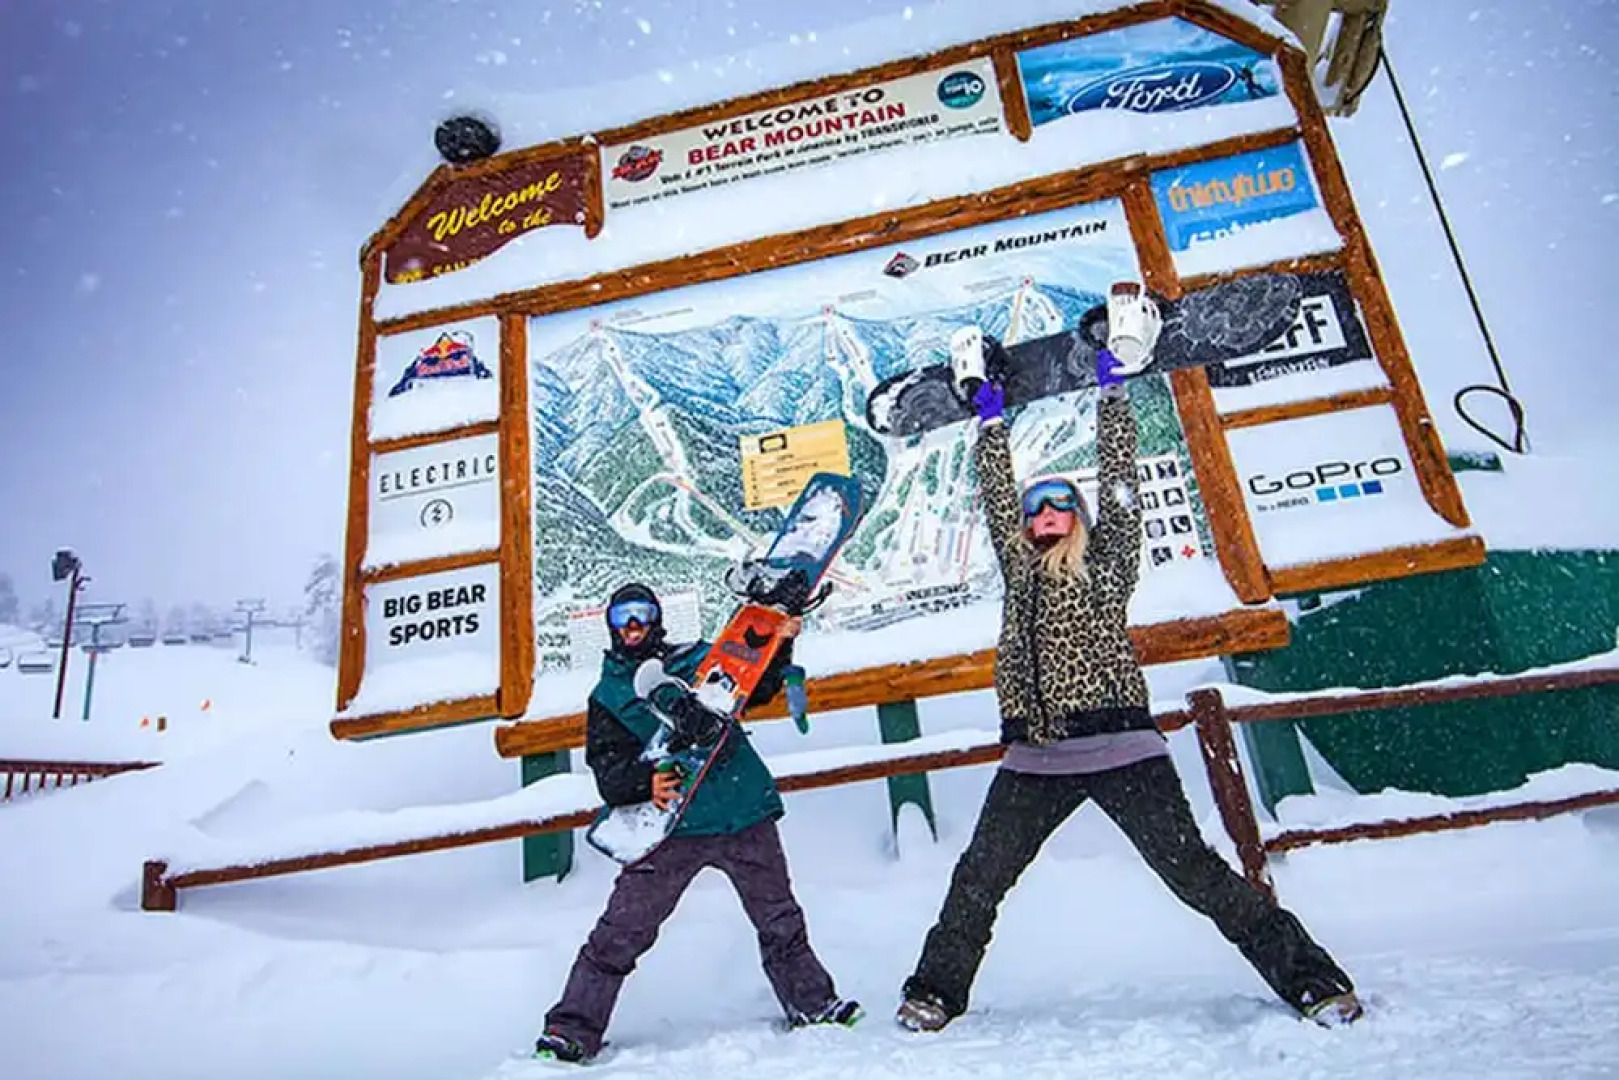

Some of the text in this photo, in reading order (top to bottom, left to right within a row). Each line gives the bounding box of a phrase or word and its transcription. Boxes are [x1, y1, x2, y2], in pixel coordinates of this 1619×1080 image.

[1101, 70, 1203, 112] Ford
[687, 136, 757, 166] BEAR
[763, 102, 907, 148] MOUNTAIN
[702, 88, 885, 140] WELCOME TO
[426, 170, 563, 242] Welcome
[1167, 166, 1296, 213] thirtytwo
[497, 207, 552, 235] to the
[924, 219, 1108, 268] BEAR MOUNTAIN
[379, 454, 496, 494] ELECTRIC
[1249, 456, 1403, 496] GoPro
[383, 583, 486, 619] BIG BEAR
[389, 613, 480, 647] SPORTS
